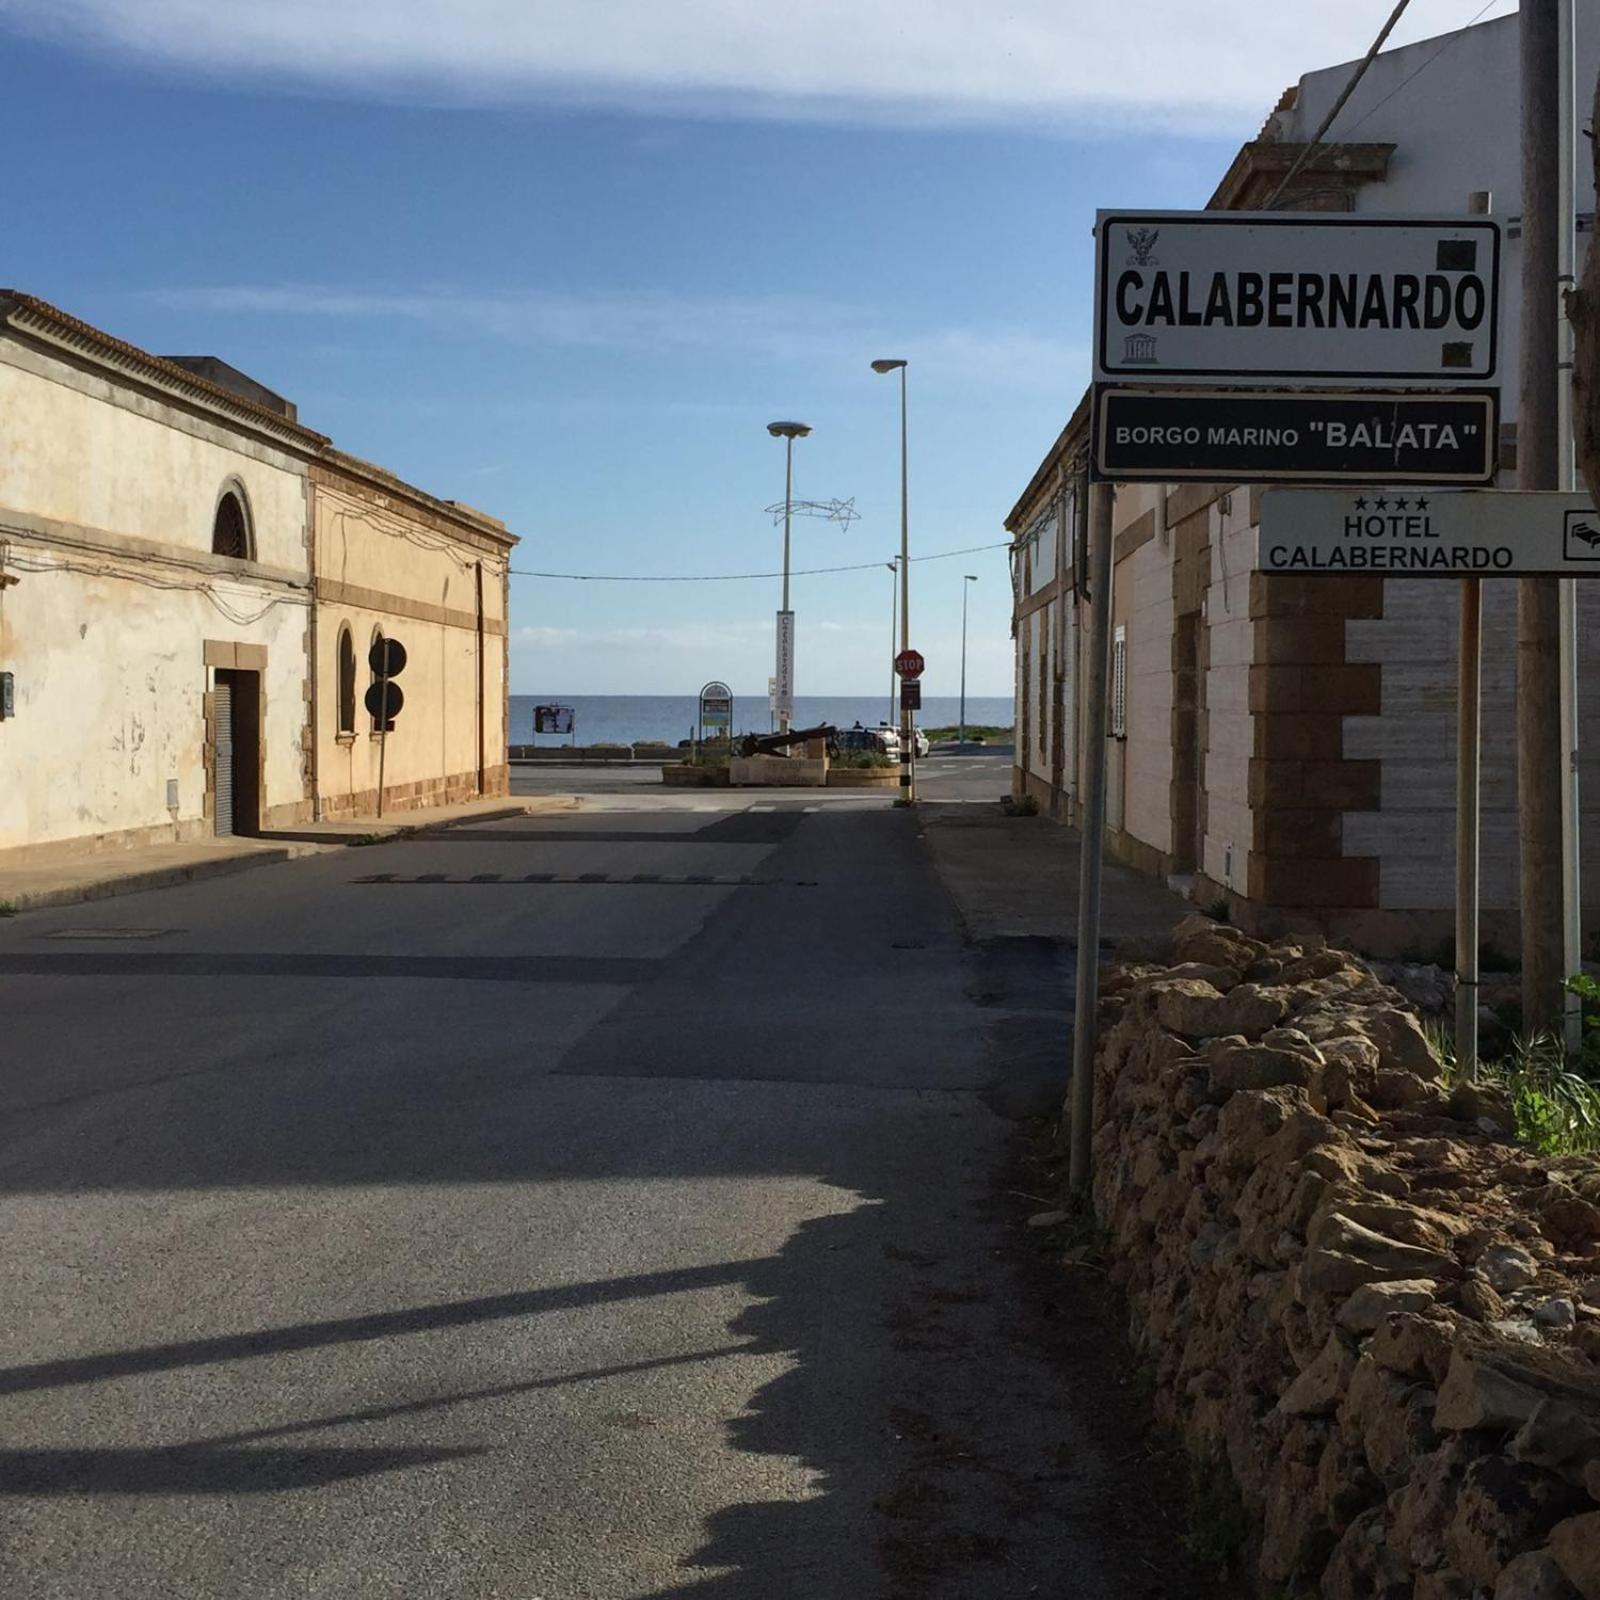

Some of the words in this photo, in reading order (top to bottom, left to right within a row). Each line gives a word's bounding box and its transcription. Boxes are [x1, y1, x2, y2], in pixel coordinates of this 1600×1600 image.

[1116, 270, 1485, 331] CALABERNARDO
[1115, 427, 1200, 445] BORGO
[1207, 427, 1299, 446] MARINO
[1309, 421, 1478, 450] "BALATA"
[1344, 516, 1440, 538] HOTEL
[1269, 546, 1513, 570] CALABERNARDO
[897, 660, 922, 671] STOP
